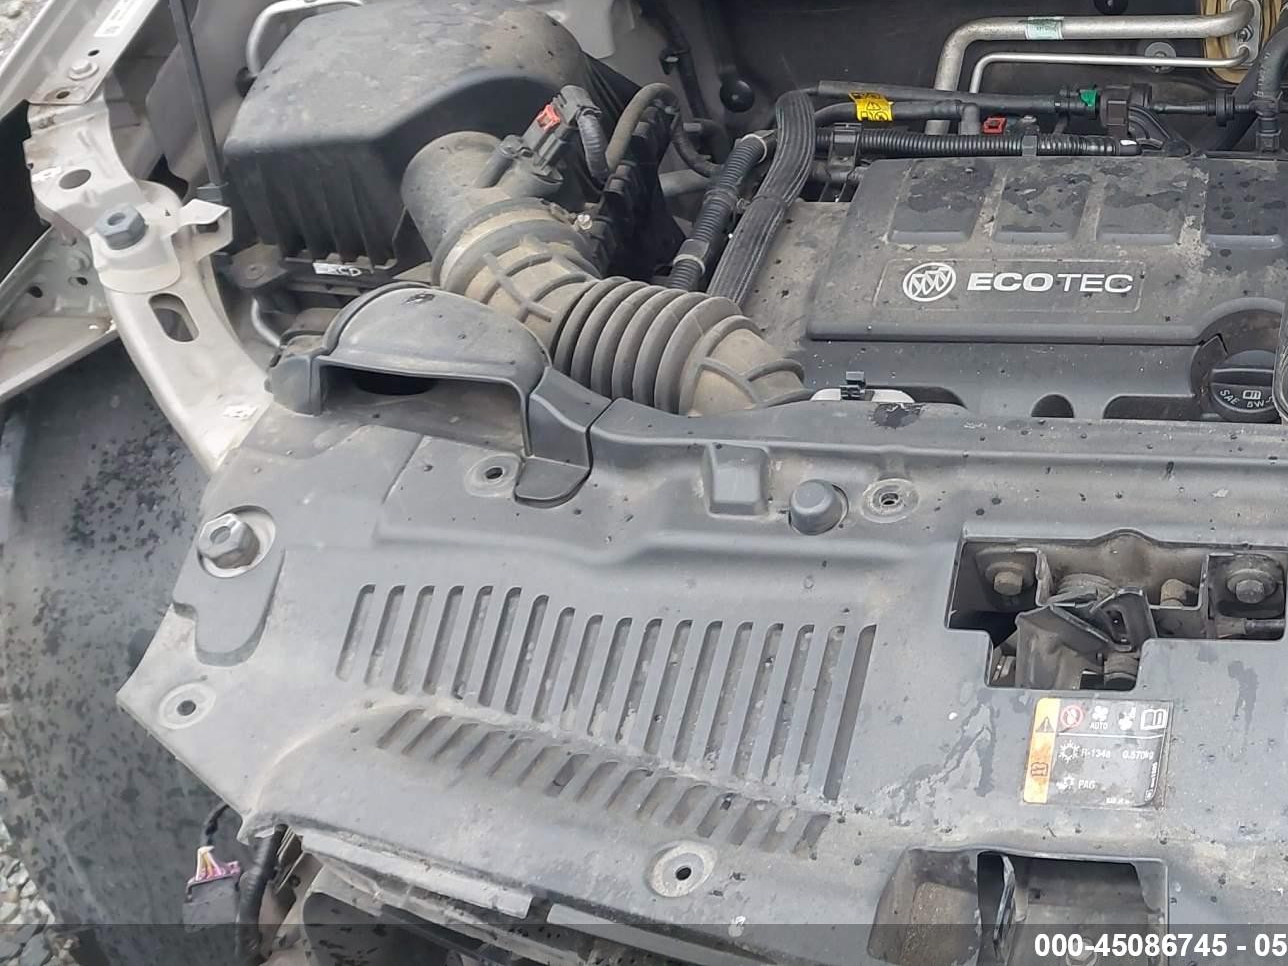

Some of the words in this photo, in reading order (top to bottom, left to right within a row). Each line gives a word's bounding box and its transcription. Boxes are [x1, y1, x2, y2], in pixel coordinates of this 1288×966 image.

[967, 272, 1134, 294] ECOTEC
[1219, 389, 1241, 405] SAE
[1089, 721, 1108, 730] AUTO
[1078, 780, 1096, 790] PAG
